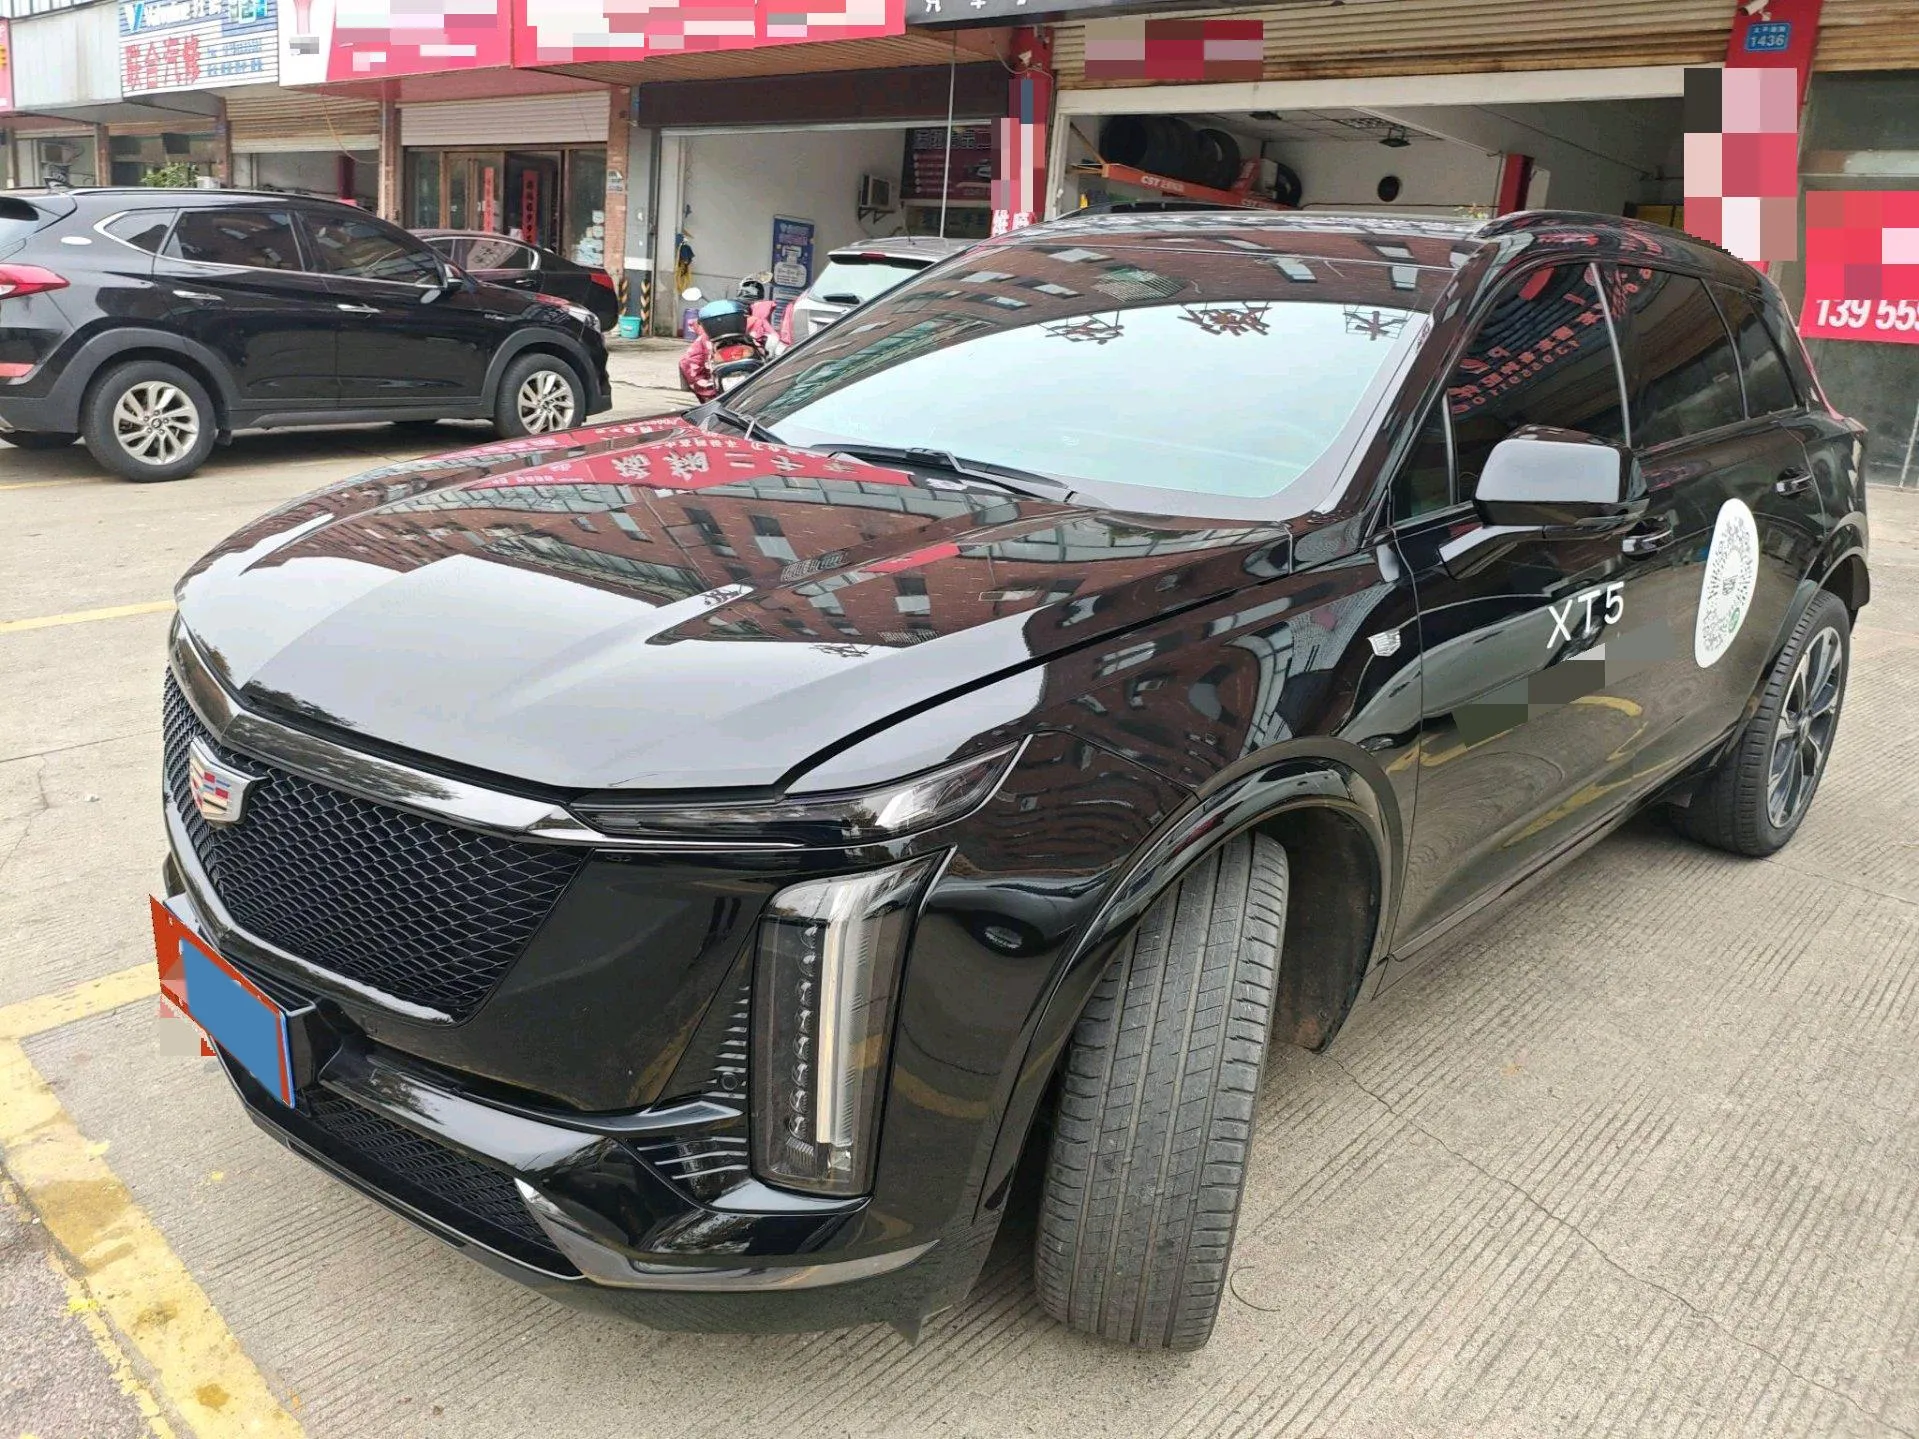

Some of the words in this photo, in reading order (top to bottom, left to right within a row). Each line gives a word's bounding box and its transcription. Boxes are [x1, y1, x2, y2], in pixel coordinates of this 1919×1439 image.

[1751, 34, 1786, 48] 1436
[1816, 299, 1872, 329] 139
[1875, 299, 1919, 331] 55
[1546, 581, 1624, 649] XT5
